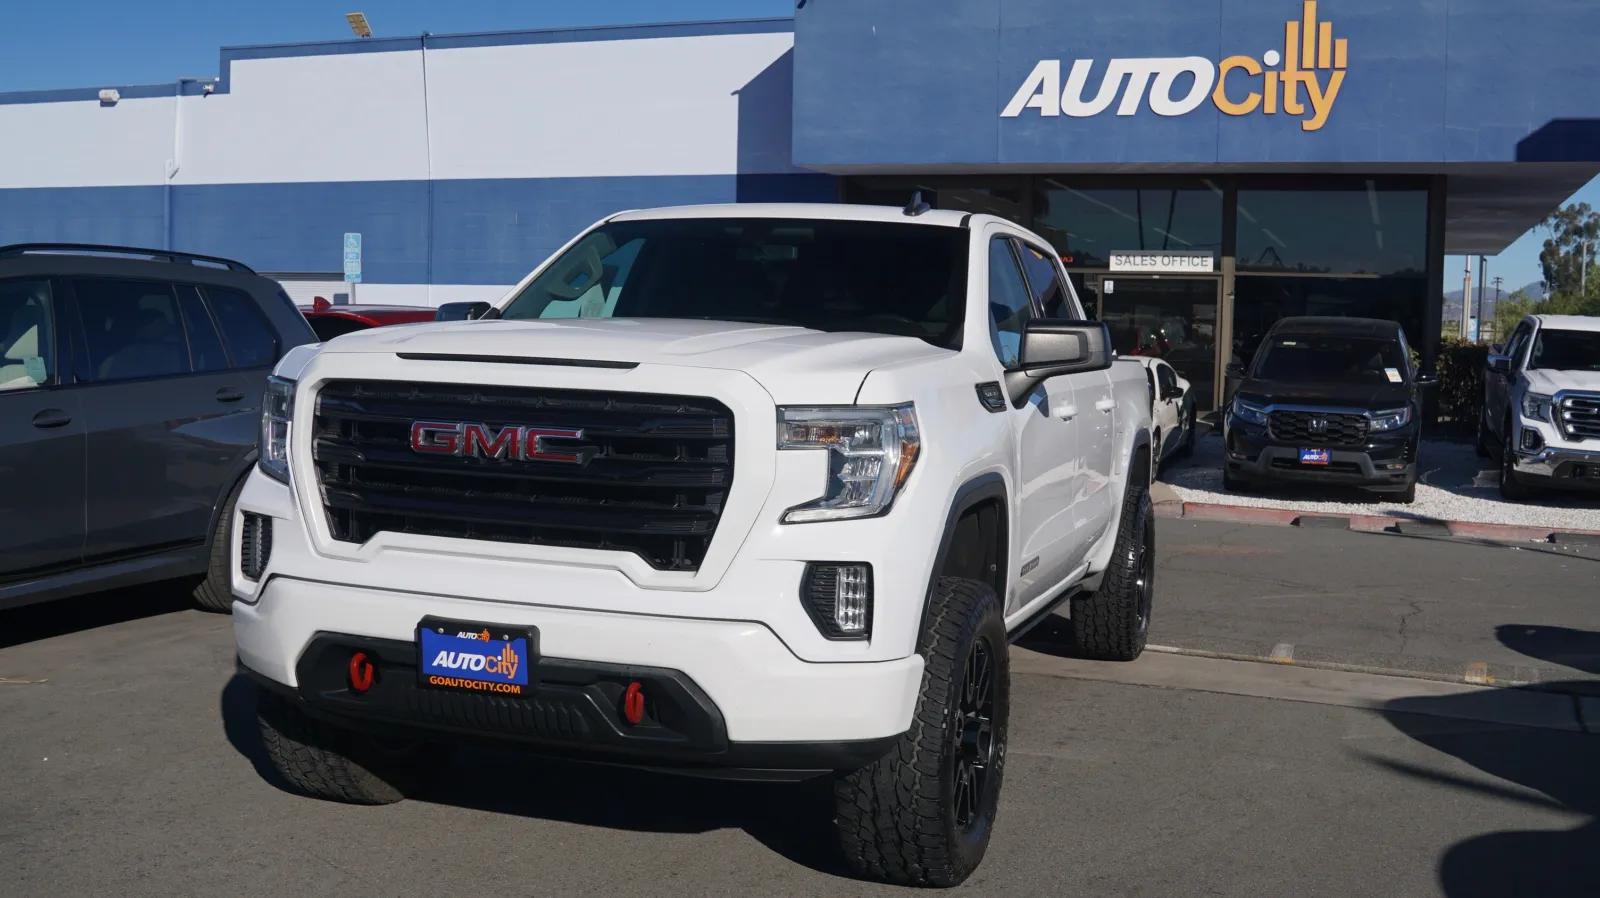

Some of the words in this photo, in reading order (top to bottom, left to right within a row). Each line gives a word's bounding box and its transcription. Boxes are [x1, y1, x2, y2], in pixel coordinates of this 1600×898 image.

[1000, 15, 1347, 131] AUTOCity
[1115, 254, 1157, 267] SALES
[1161, 255, 1209, 267] OFFICE
[411, 421, 584, 464] GMC
[432, 645, 519, 680] AUTOCity
[429, 675, 521, 694] GOAUTOCITY.COM
